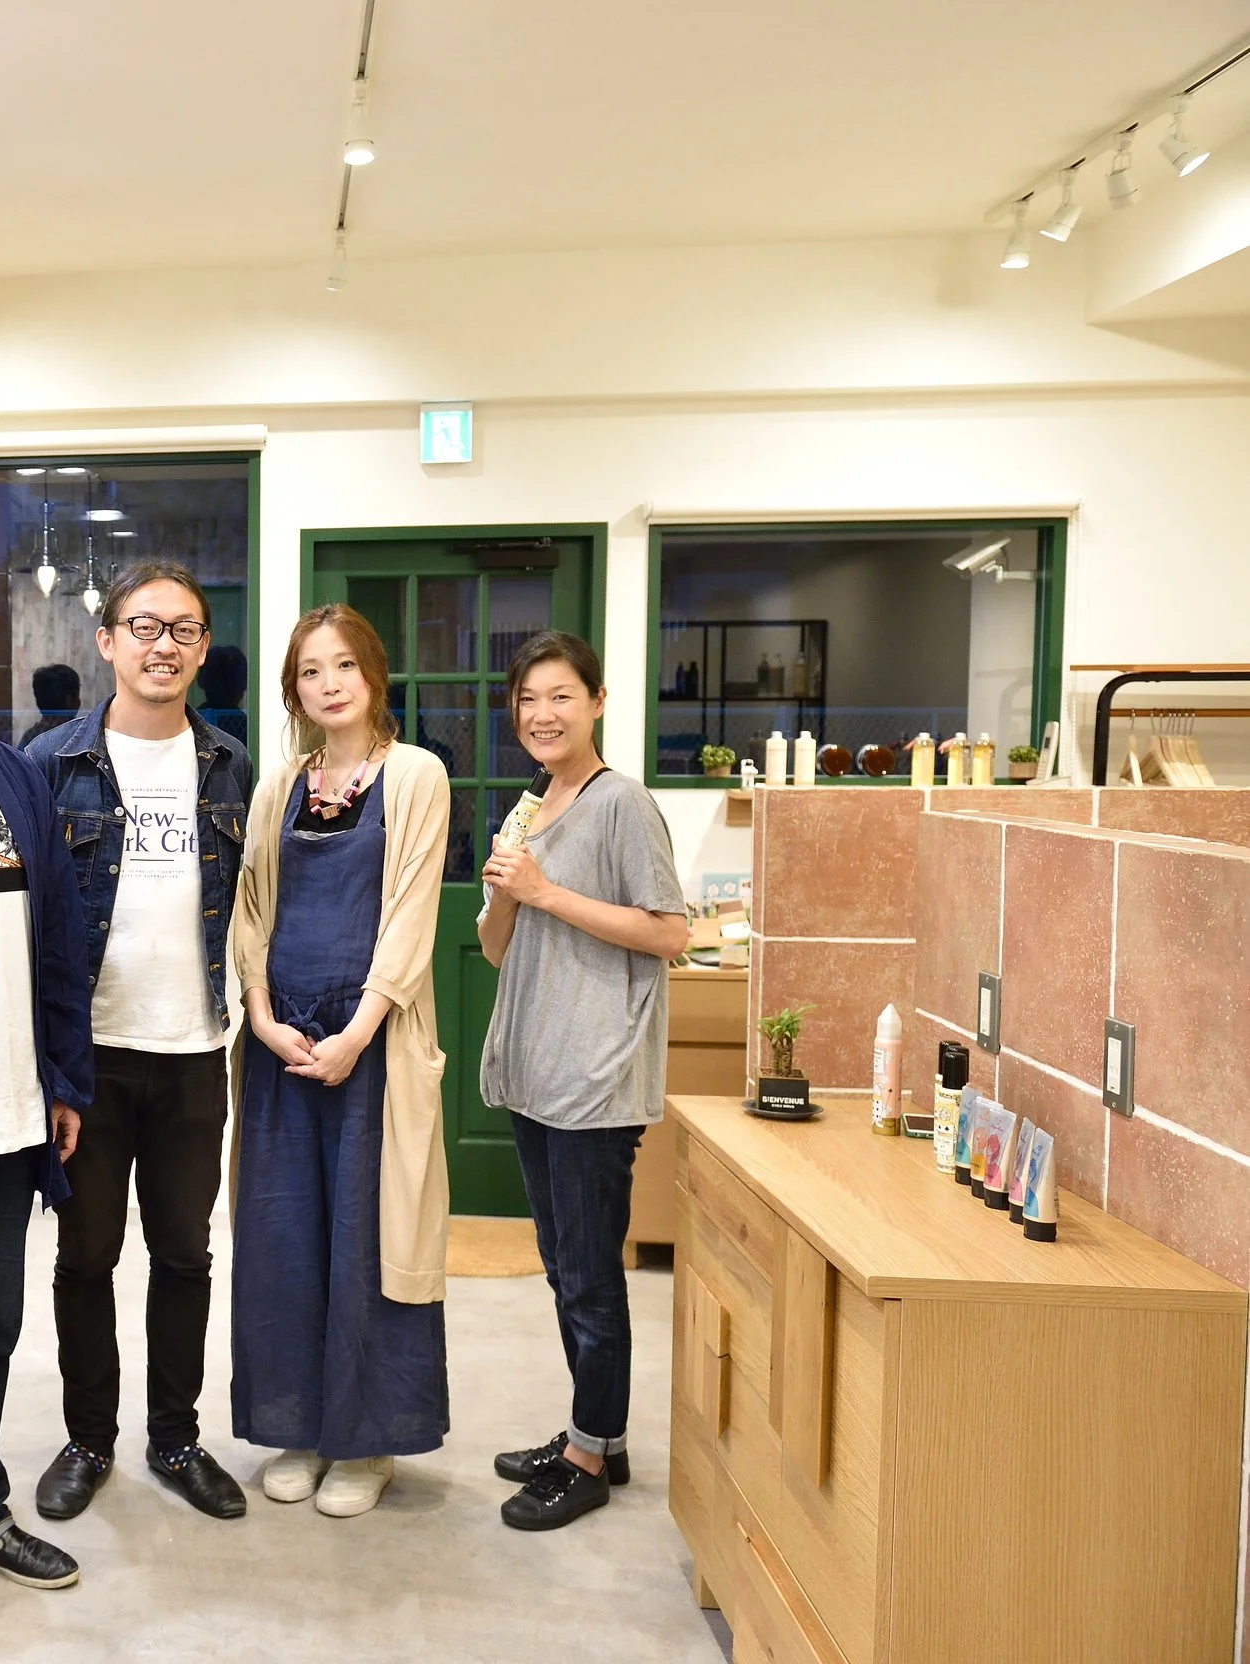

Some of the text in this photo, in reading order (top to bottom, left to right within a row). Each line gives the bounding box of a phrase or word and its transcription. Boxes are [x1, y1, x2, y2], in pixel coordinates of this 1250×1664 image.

[125, 827, 199, 853] rk Cit
[762, 1096, 804, 1105] BIENVENUE
